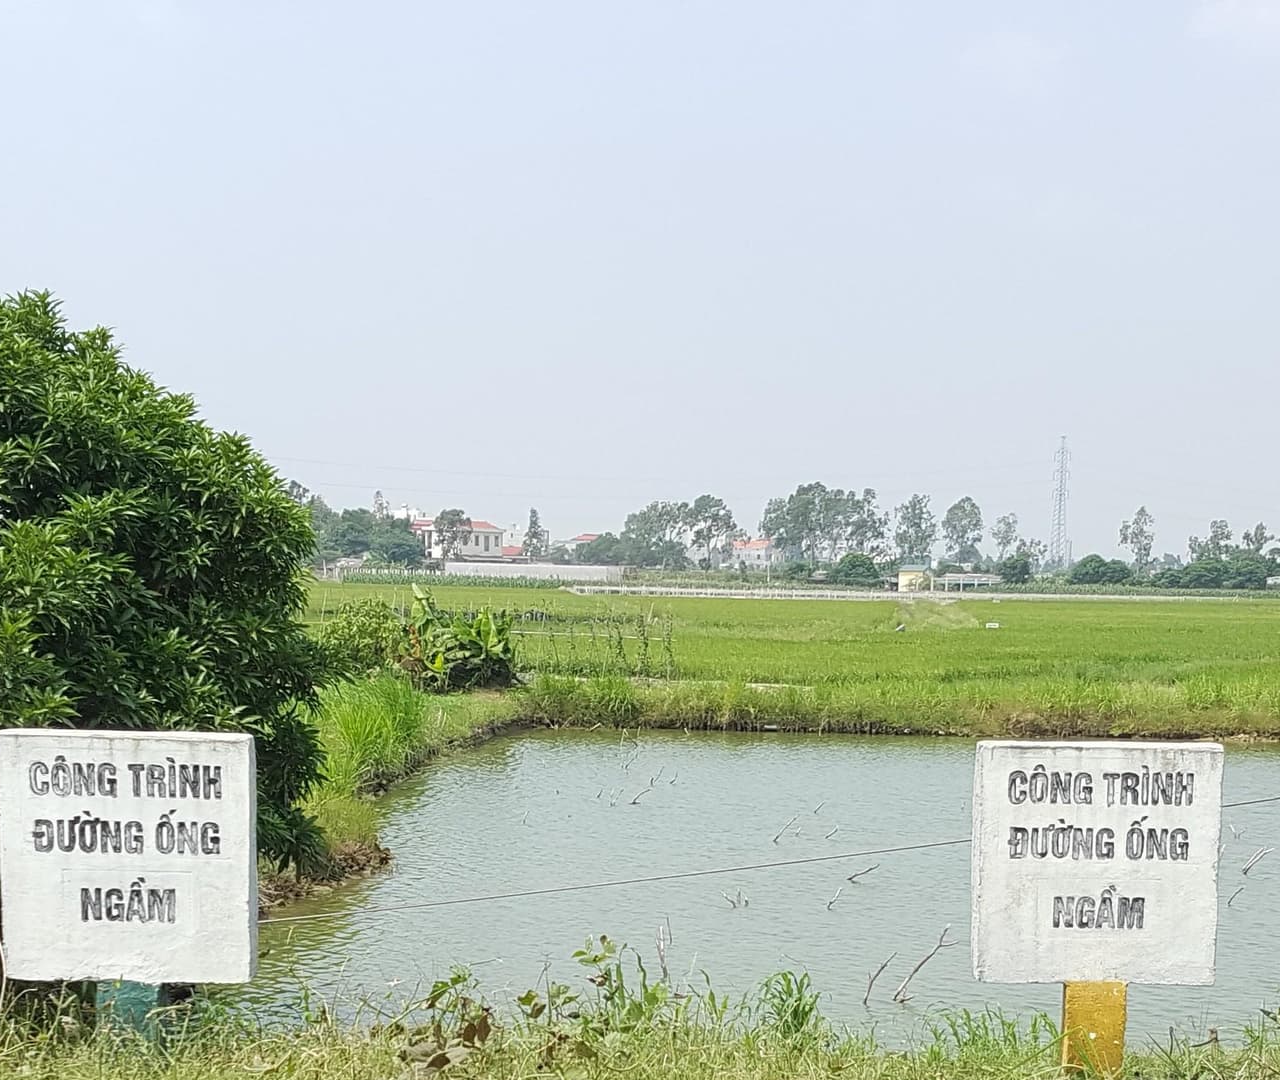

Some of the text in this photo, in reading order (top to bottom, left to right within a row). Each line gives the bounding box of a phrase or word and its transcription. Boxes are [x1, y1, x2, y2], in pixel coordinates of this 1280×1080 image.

[28, 755, 222, 799] CÔNG TRÌNH
[1007, 764, 1195, 807] CÔNG TRÌNH
[31, 809, 221, 855] ĐƯỜNG ỐNG
[1007, 815, 1190, 860] ĐƯỜNG ỐNG
[80, 877, 176, 923] NGẦM
